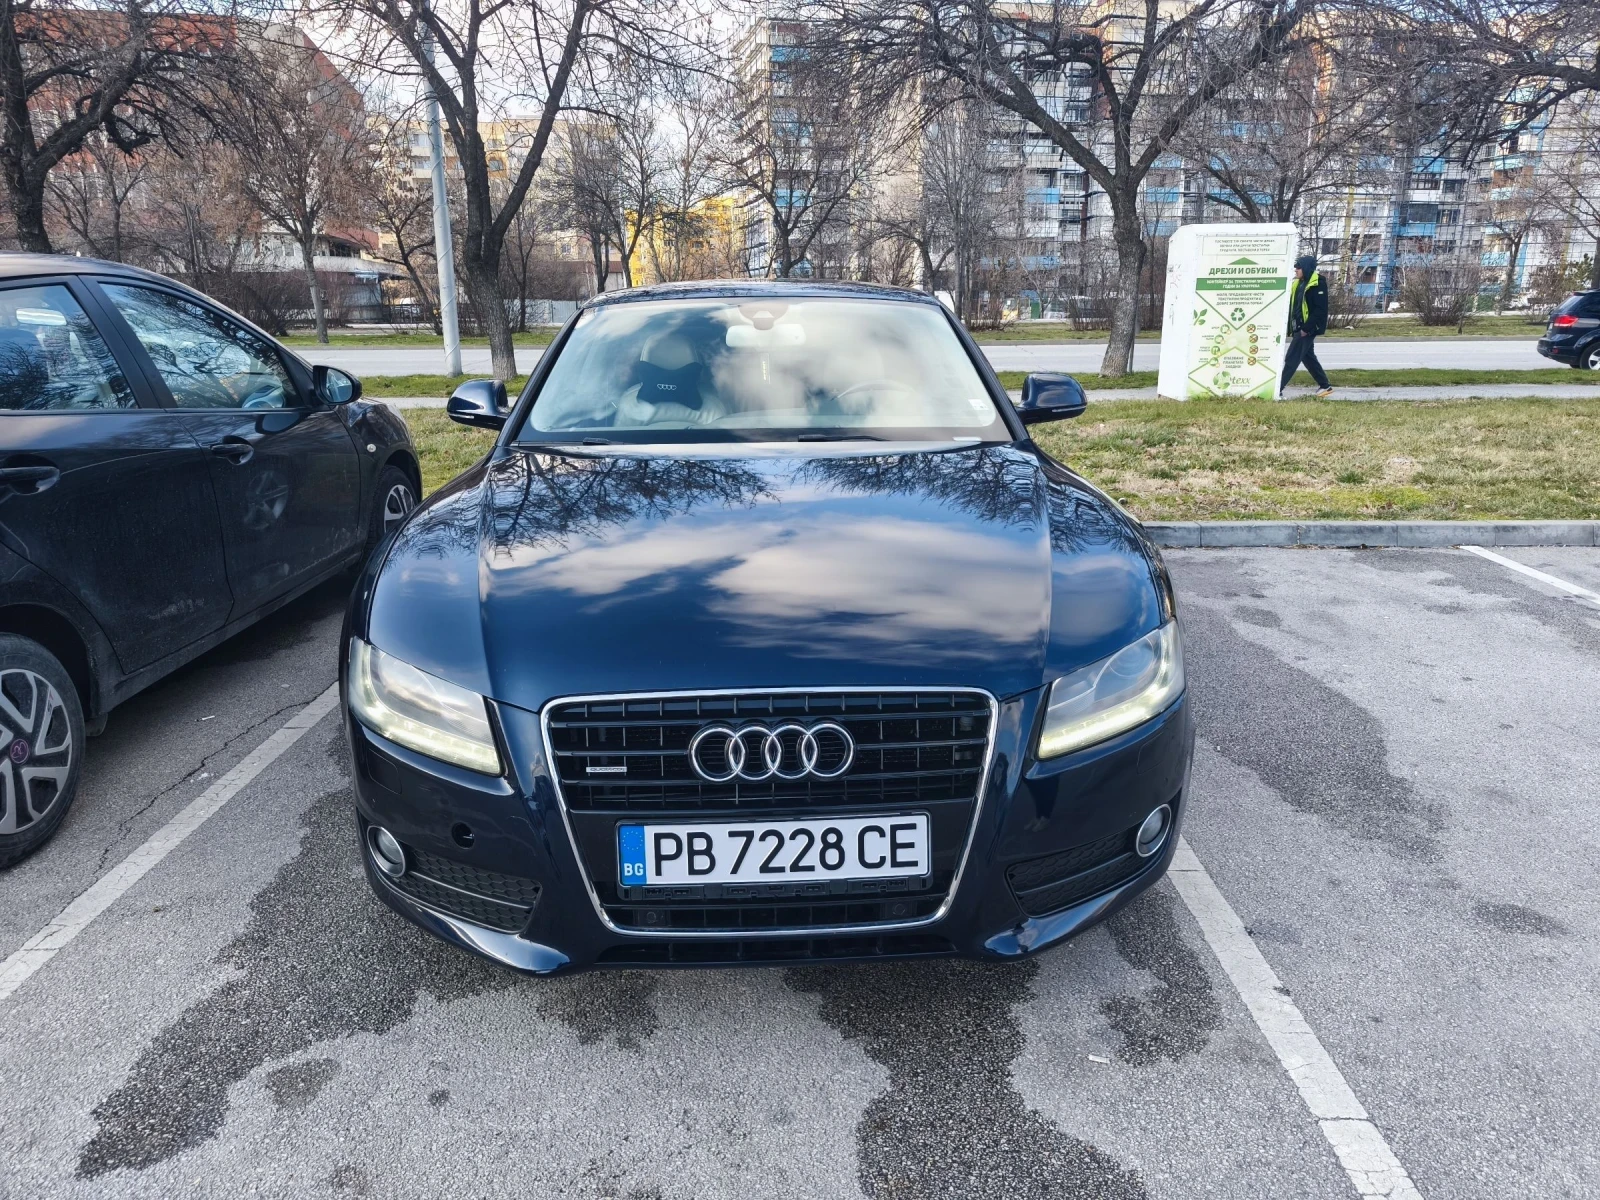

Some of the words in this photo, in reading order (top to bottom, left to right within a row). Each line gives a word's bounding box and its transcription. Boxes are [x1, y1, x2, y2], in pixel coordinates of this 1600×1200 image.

[1208, 267, 1237, 276] ДРЕХИ
[1237, 267, 1244, 275] И
[1245, 267, 1278, 275] ОБУВКИ
[653, 831, 716, 877] PB
[727, 826, 846, 875] 7228
[857, 822, 919, 870] CE
[624, 863, 644, 876] BG
